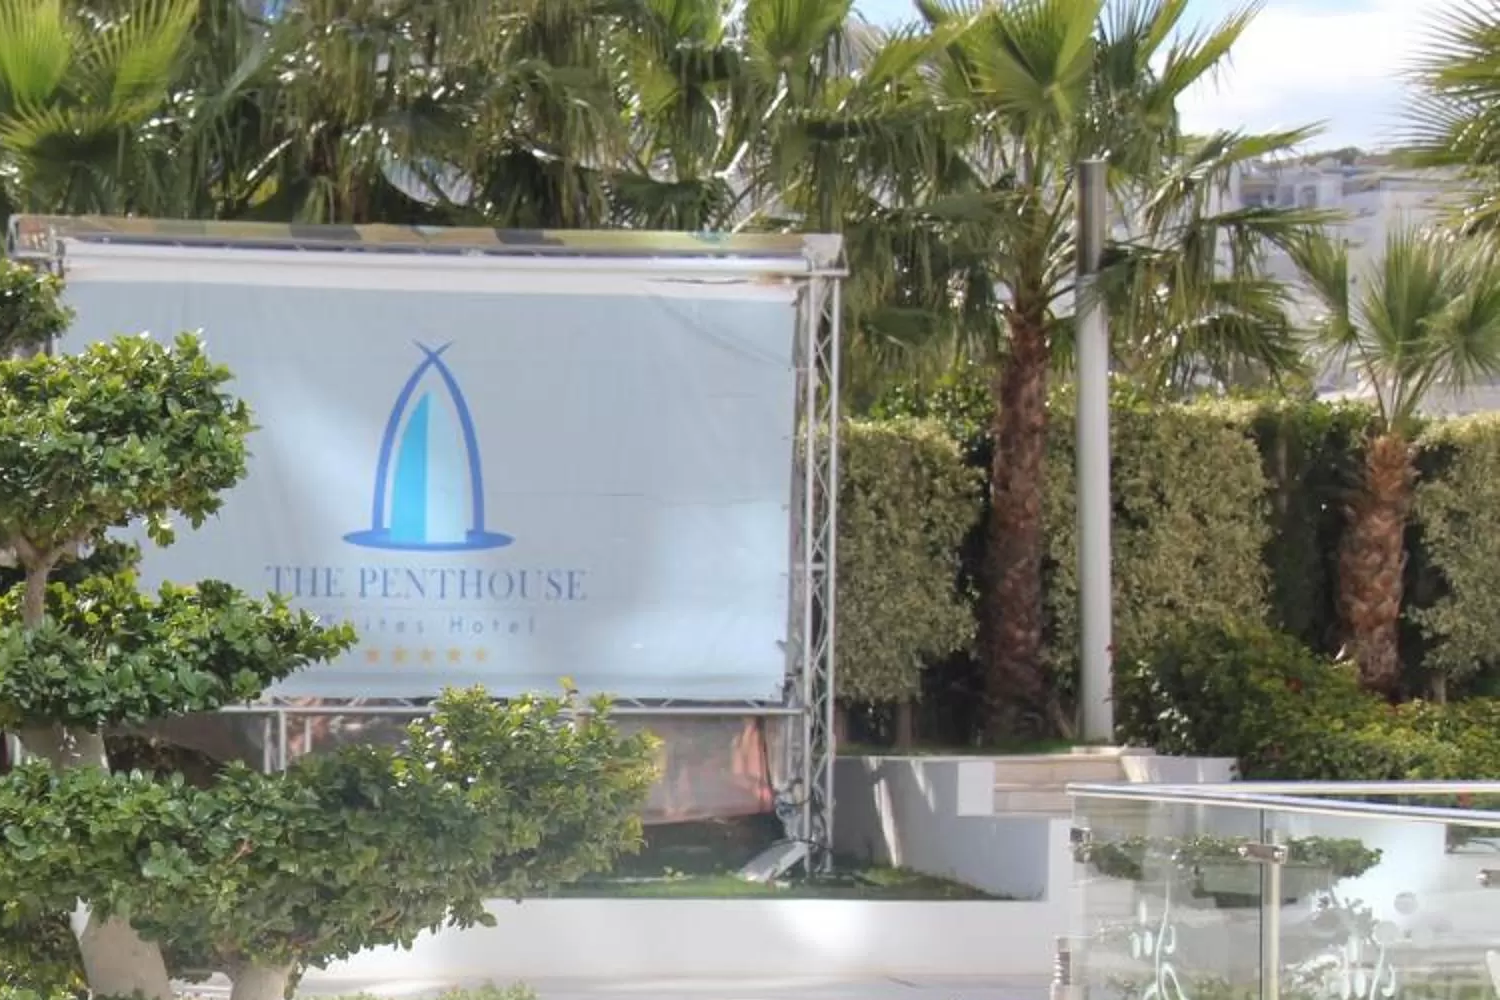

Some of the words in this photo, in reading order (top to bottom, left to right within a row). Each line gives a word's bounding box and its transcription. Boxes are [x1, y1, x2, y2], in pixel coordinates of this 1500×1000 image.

[264, 565, 346, 598] THE
[358, 566, 589, 600] PENTHOUSE
[321, 613, 425, 633] Sites
[449, 615, 534, 635] Hotel
